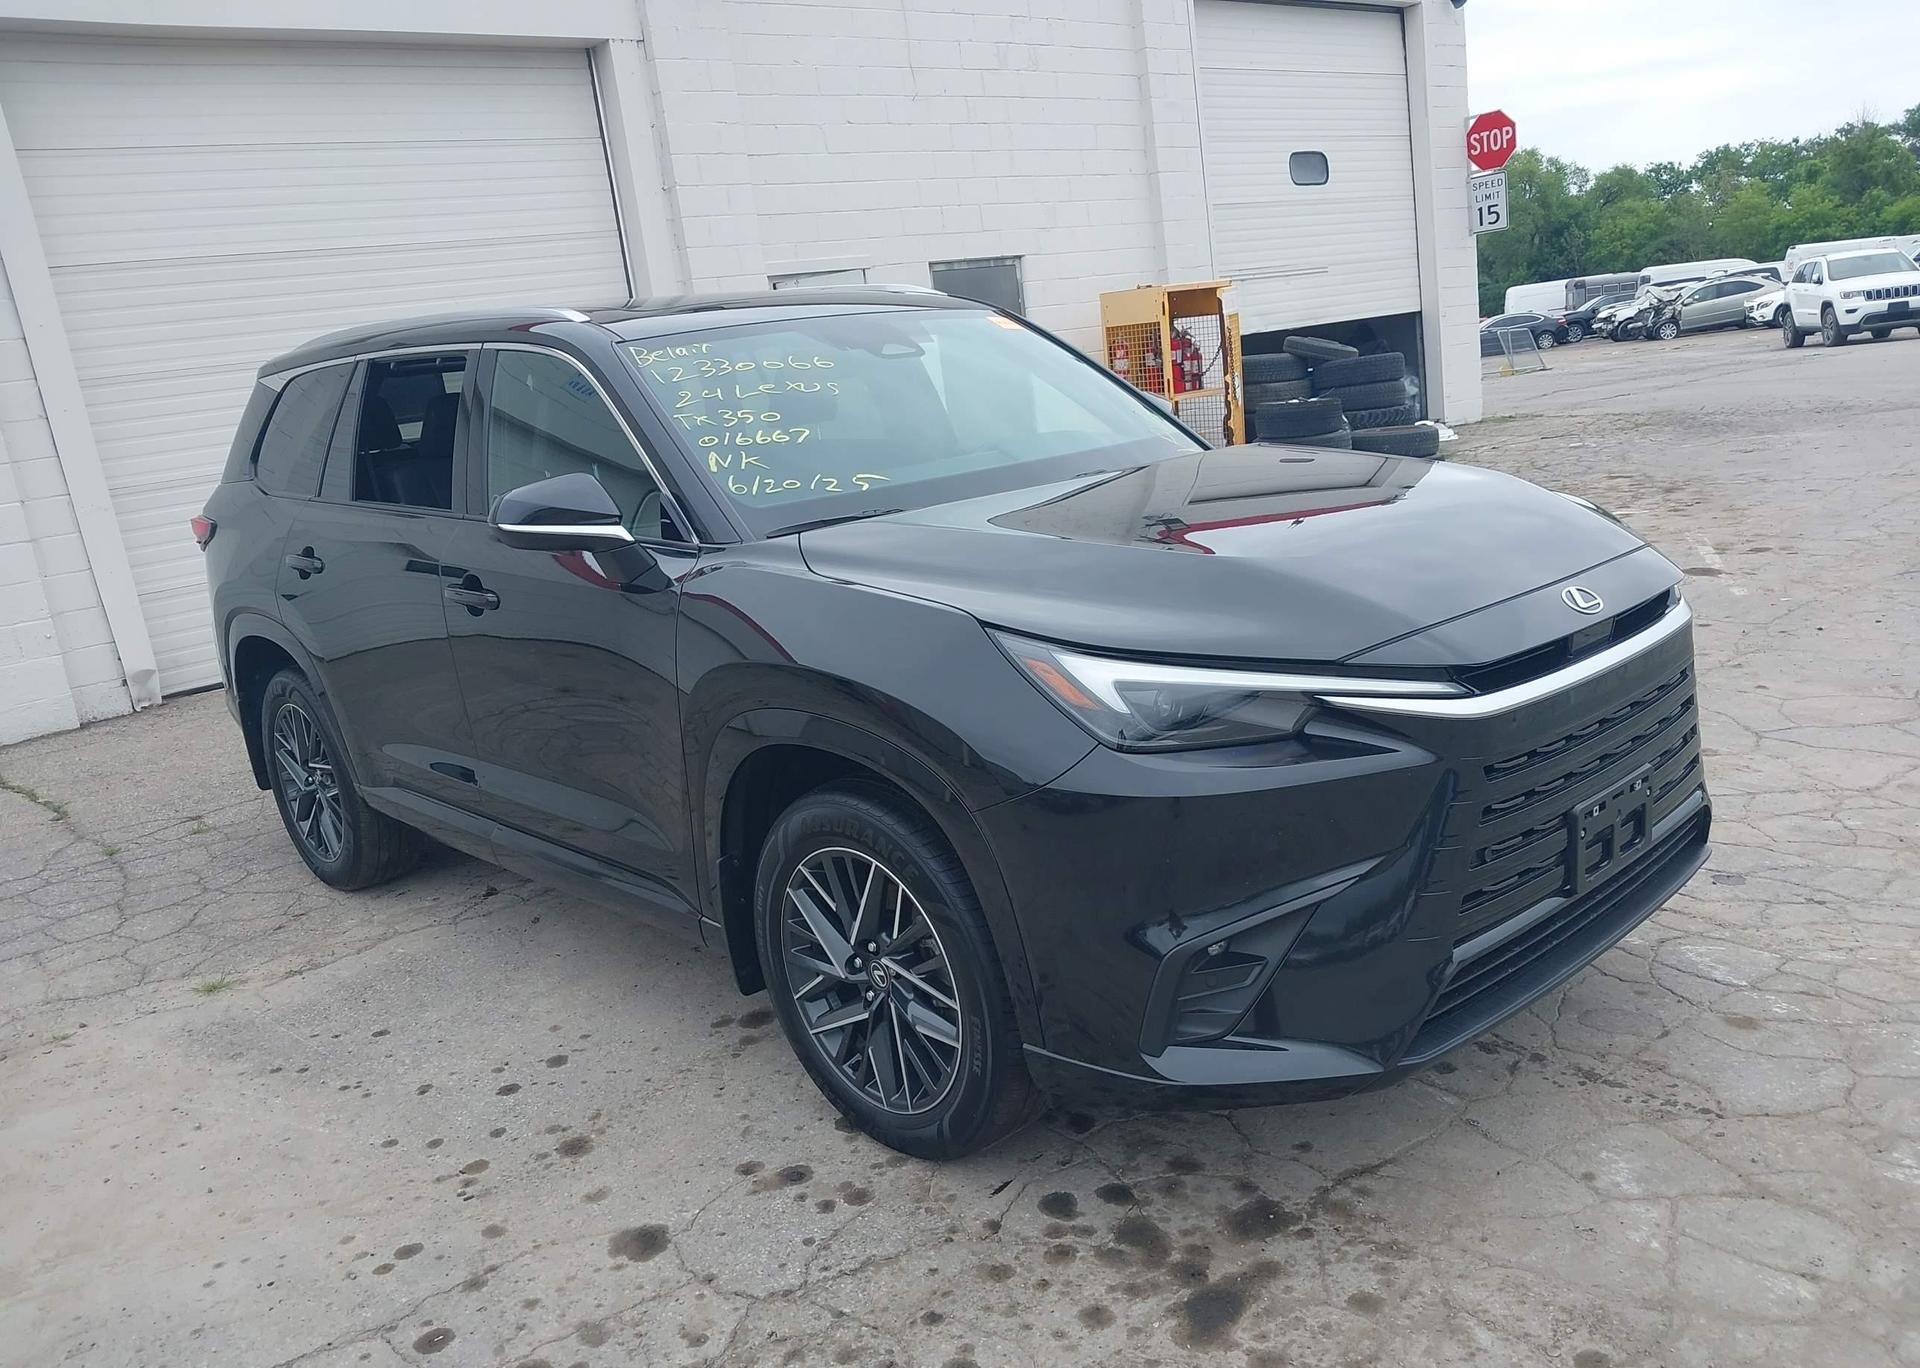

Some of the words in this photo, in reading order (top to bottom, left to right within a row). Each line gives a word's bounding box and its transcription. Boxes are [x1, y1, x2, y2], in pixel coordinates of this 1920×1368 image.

[1470, 125, 1513, 156] STOP
[1472, 178, 1504, 192] SPEED
[1475, 191, 1501, 204] LIMIT
[1477, 203, 1501, 227] 15
[650, 355, 835, 384] 12330066
[698, 428, 810, 447] 016667
